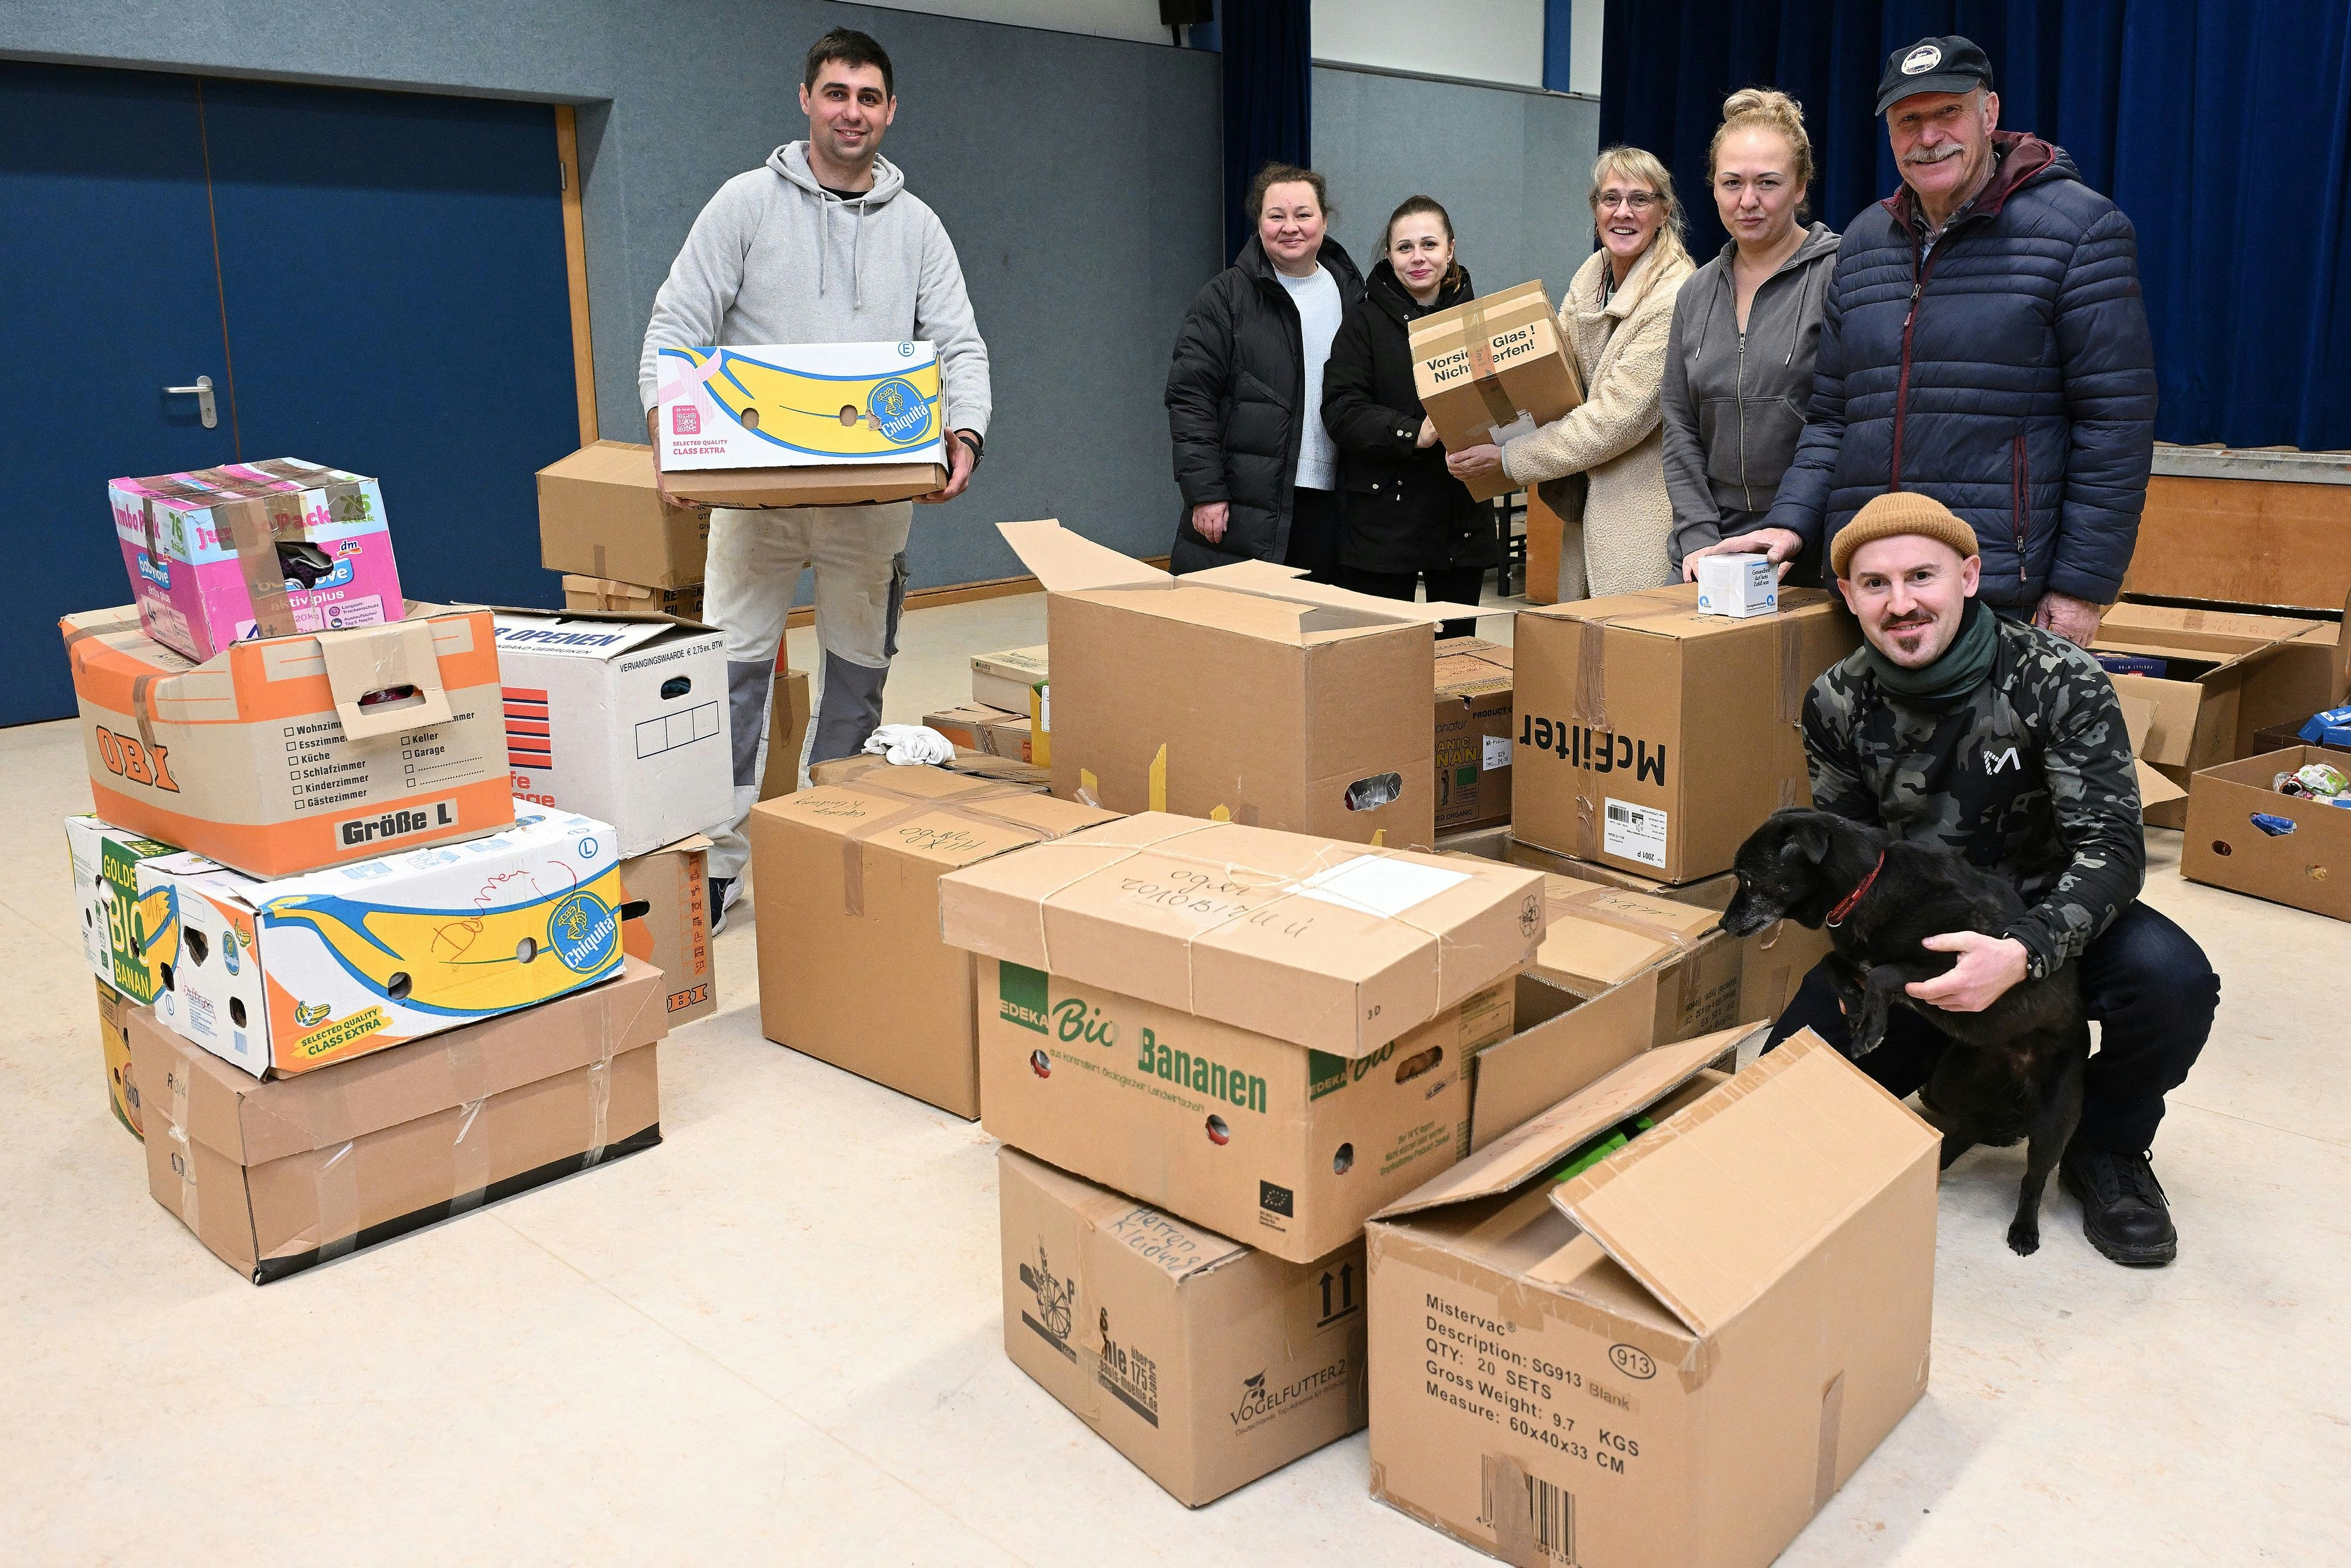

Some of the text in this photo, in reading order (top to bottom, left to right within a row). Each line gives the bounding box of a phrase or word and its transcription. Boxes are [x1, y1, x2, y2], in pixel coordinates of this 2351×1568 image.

[903, 343, 910, 354] E
[1493, 330, 1526, 348] Glas
[1493, 339, 1535, 363] erfen!
[882, 403, 929, 437] Chiquita
[340, 494, 371, 514] 76
[169, 511, 184, 544] 76
[341, 514, 375, 524] Stück
[341, 541, 357, 551] dm
[313, 590, 344, 605] plus
[343, 604, 379, 614] Trockenschutz
[344, 611, 378, 621] Auslaufsicher
[505, 629, 625, 647] OPENEN
[532, 646, 592, 655] GEBRUIKEN
[619, 649, 684, 673] VERVANGINGSWAARDE
[686, 648, 692, 656] €
[692, 645, 704, 655] 2,75
[711, 639, 724, 651] BTW
[1473, 708, 1506, 719] PRODUCT
[412, 732, 438, 744] Keller
[96, 725, 180, 793] OBI
[301, 752, 330, 764] Küche
[414, 745, 446, 758] Garage
[1519, 715, 1667, 786] McFilter
[303, 759, 366, 779] Schlafzimmer
[305, 774, 369, 793] Kinderzimmer
[307, 789, 367, 808] Gästezimmer
[342, 803, 452, 845] Größe L
[1446, 809, 1472, 819] ORGANIC
[584, 842, 592, 855] L
[1643, 851, 1655, 861] 2001
[564, 916, 616, 970] Chiquita
[667, 983, 708, 1013] BI
[1000, 998, 1049, 1028] EDEKA
[301, 1009, 377, 1047] SELECTED QUALITY
[308, 1018, 381, 1056] CLASS EXTRA
[1138, 1027, 1267, 1114] Bananen
[1426, 1315, 1630, 1411] Description: SG913 Blank
[1426, 1337, 1552, 1401] QTY: 20 SETS
[1616, 1349, 1650, 1375] 913
[1131, 1361, 1147, 1391] 175
[1426, 1359, 1640, 1457] Gross Weight: 9.7 KGS
[1426, 1381, 1625, 1475] Measure: 60x40x33 CM
